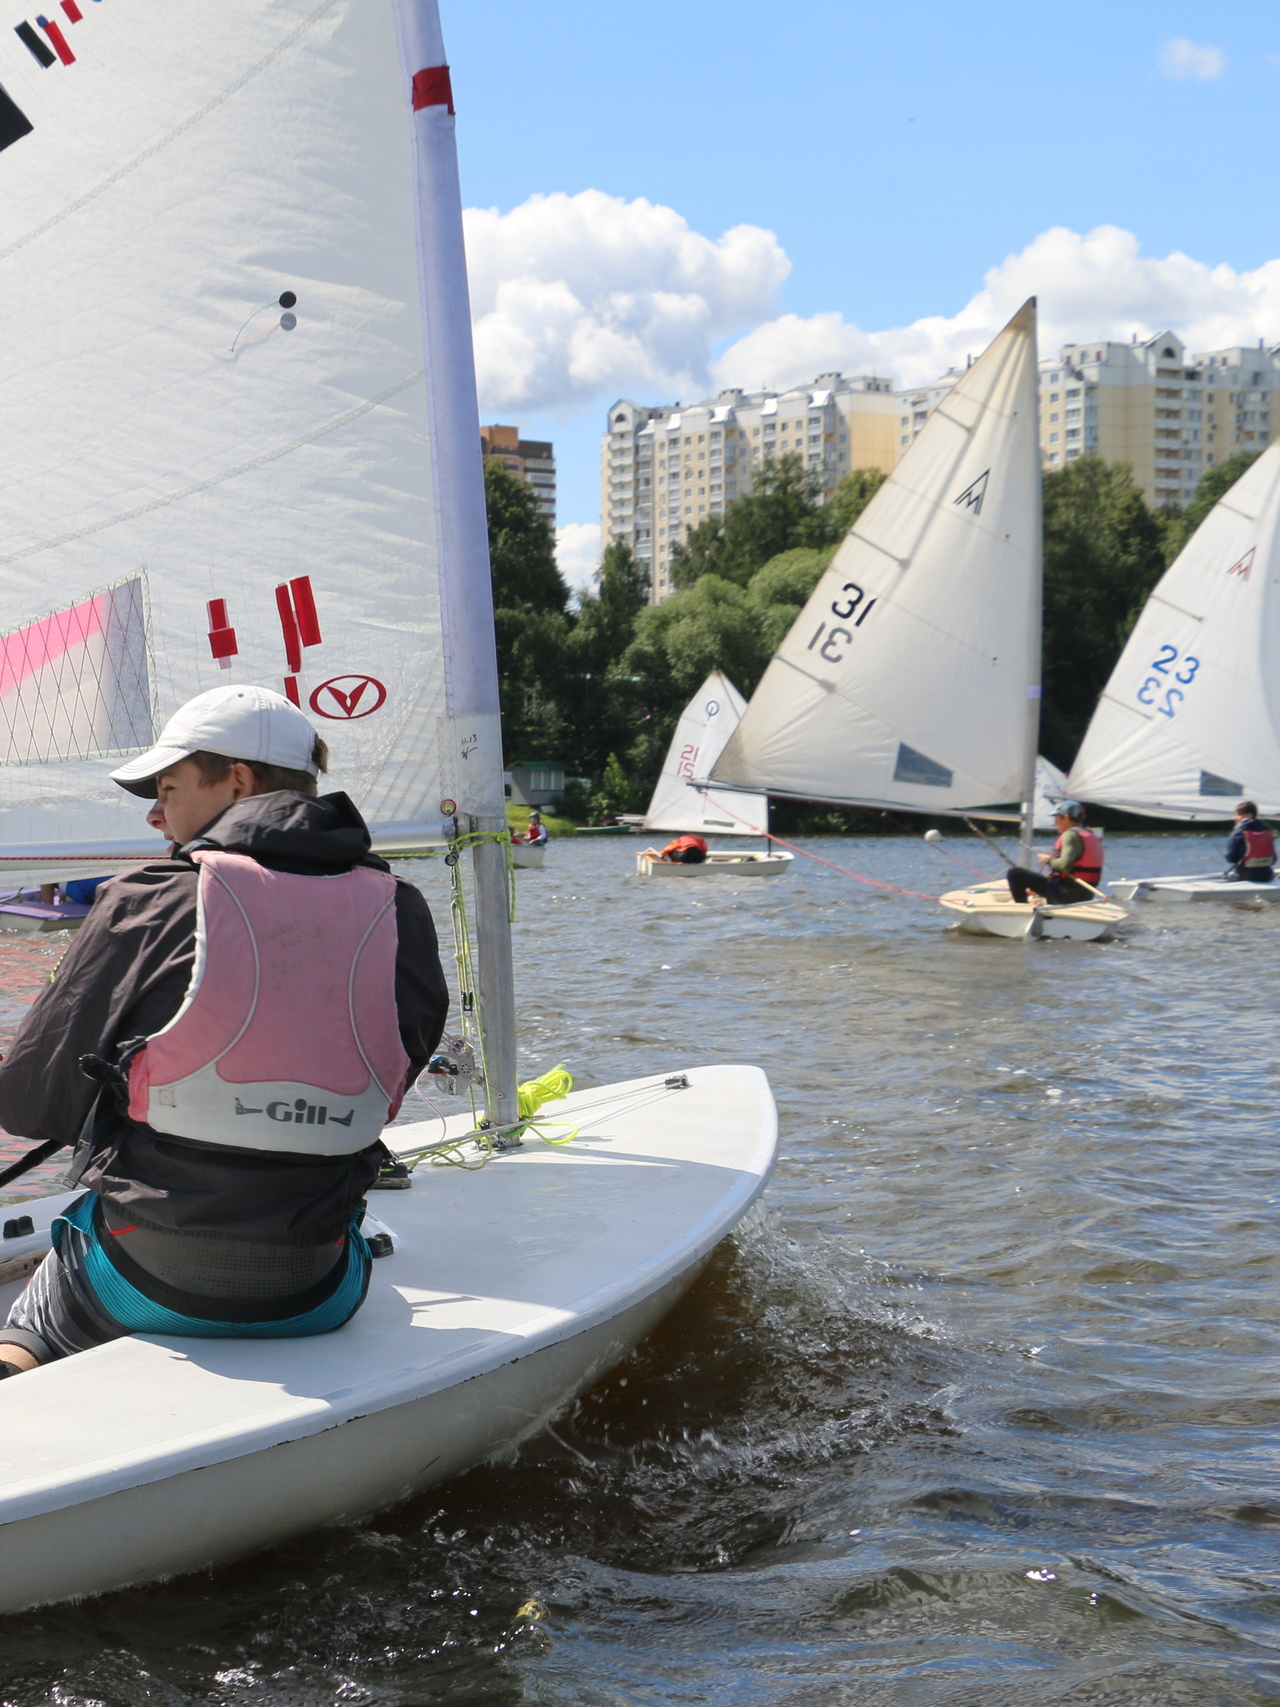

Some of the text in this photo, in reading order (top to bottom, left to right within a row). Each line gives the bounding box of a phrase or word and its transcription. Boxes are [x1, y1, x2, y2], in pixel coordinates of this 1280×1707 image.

[831, 582, 878, 628] 31
[1151, 644, 1201, 685] 23
[266, 1098, 328, 1125] Gill
